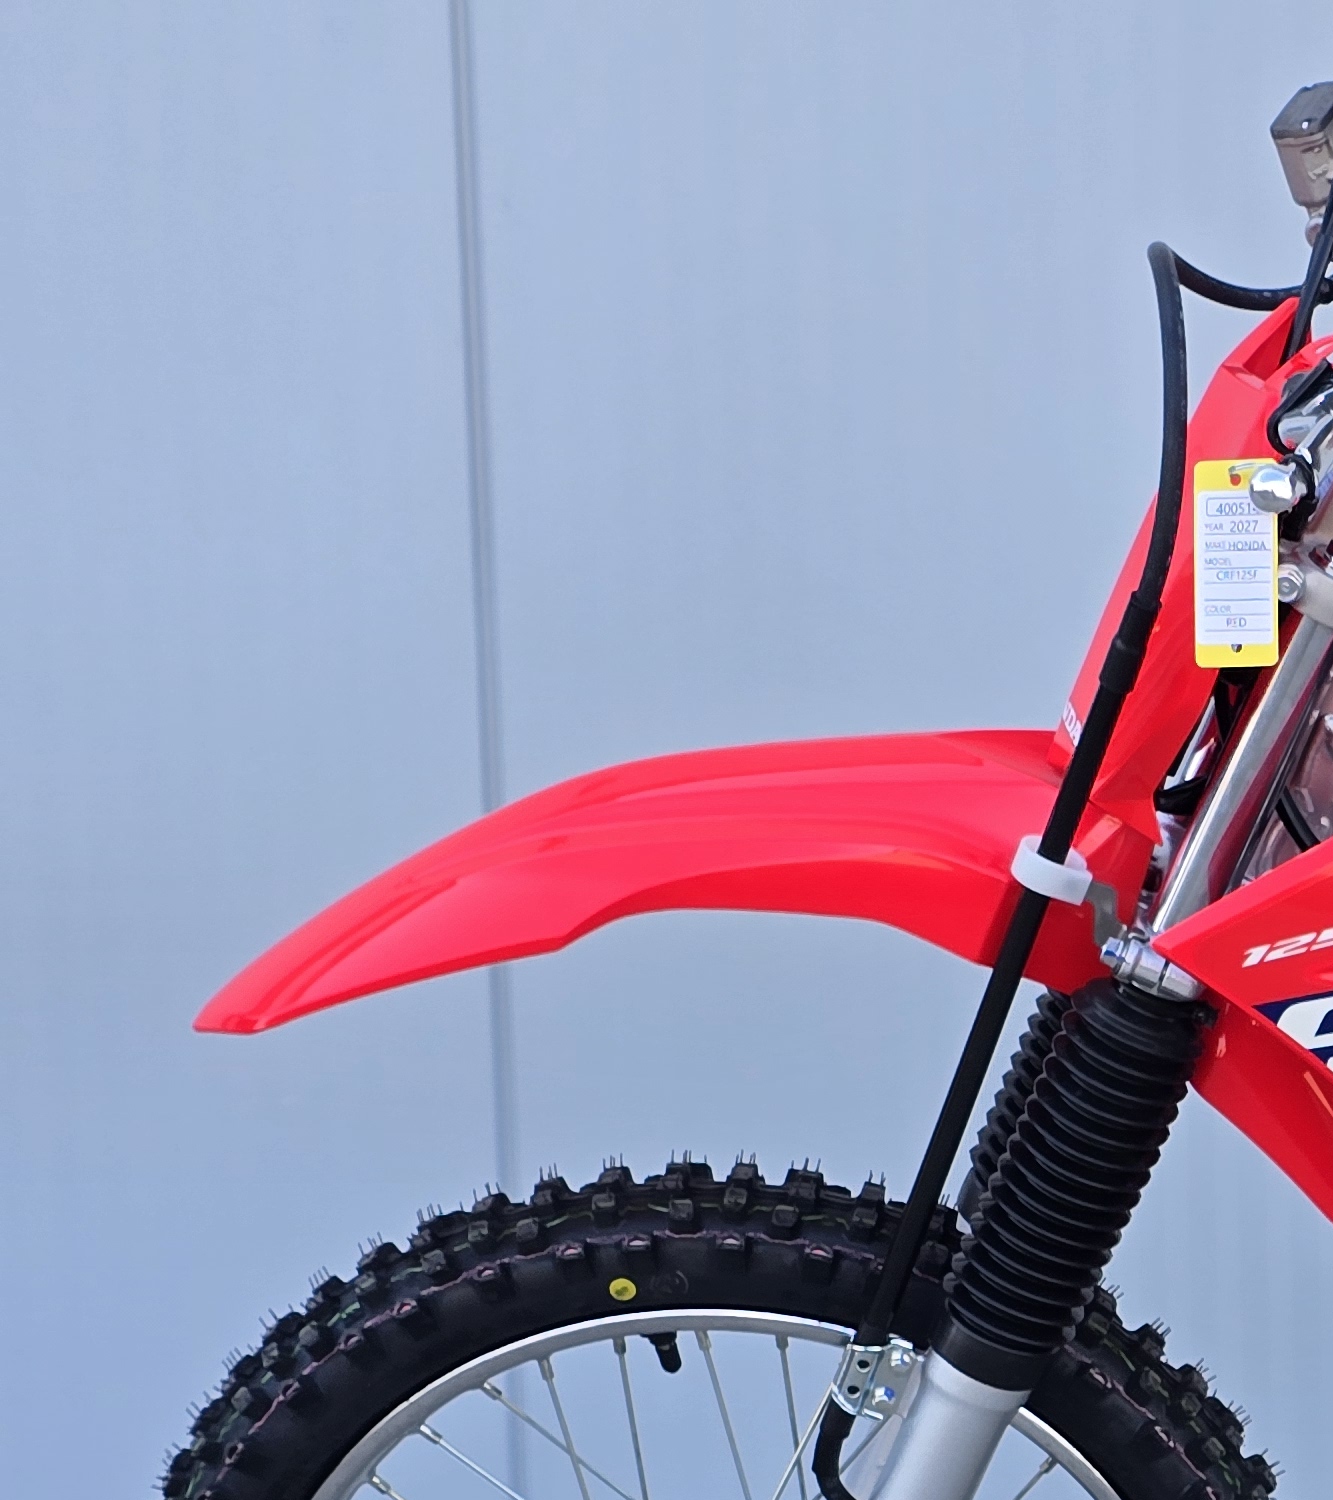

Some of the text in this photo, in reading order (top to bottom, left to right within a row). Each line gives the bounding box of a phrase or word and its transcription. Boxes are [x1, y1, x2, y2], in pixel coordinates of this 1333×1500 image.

[1216, 502, 1259, 515] 40051
[1230, 519, 1258, 533] 2027
[1228, 540, 1267, 552] HONDA
